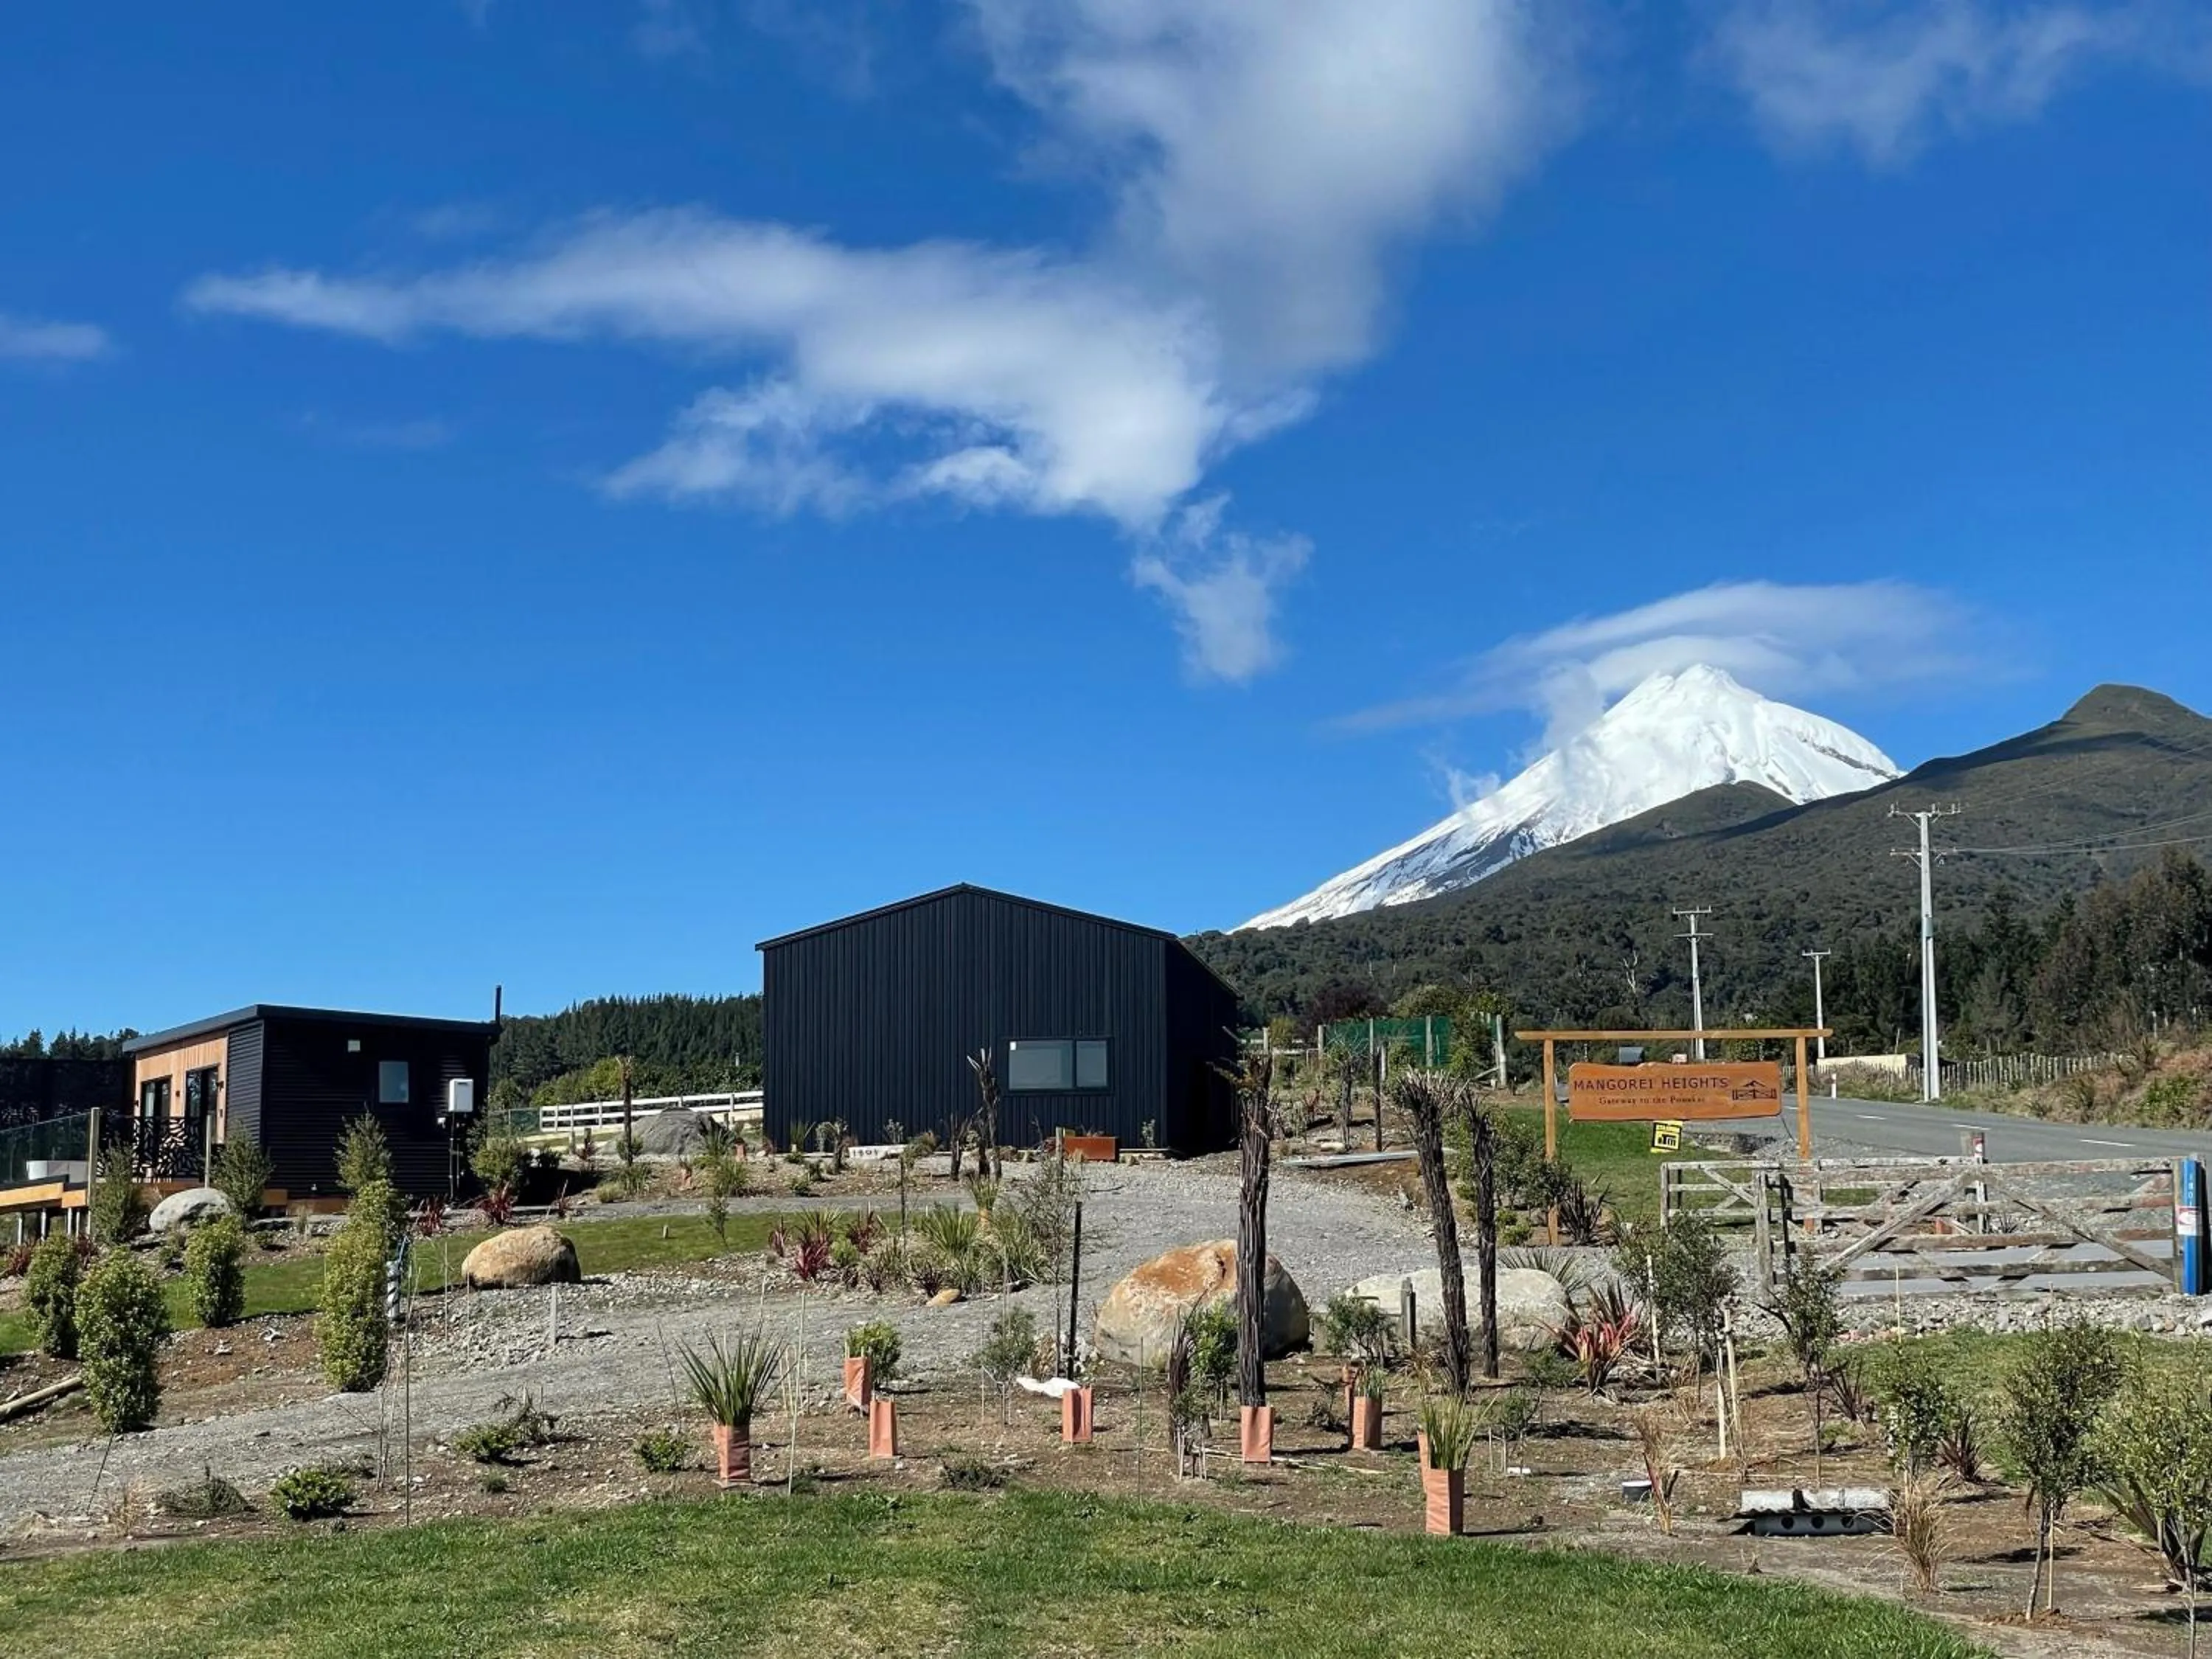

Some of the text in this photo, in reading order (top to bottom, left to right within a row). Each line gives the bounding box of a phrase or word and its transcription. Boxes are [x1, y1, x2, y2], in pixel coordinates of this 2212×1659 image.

[1573, 1077, 1729, 1091] MANGOREI HEIGHTS
[1652, 1096, 1666, 1104] the
